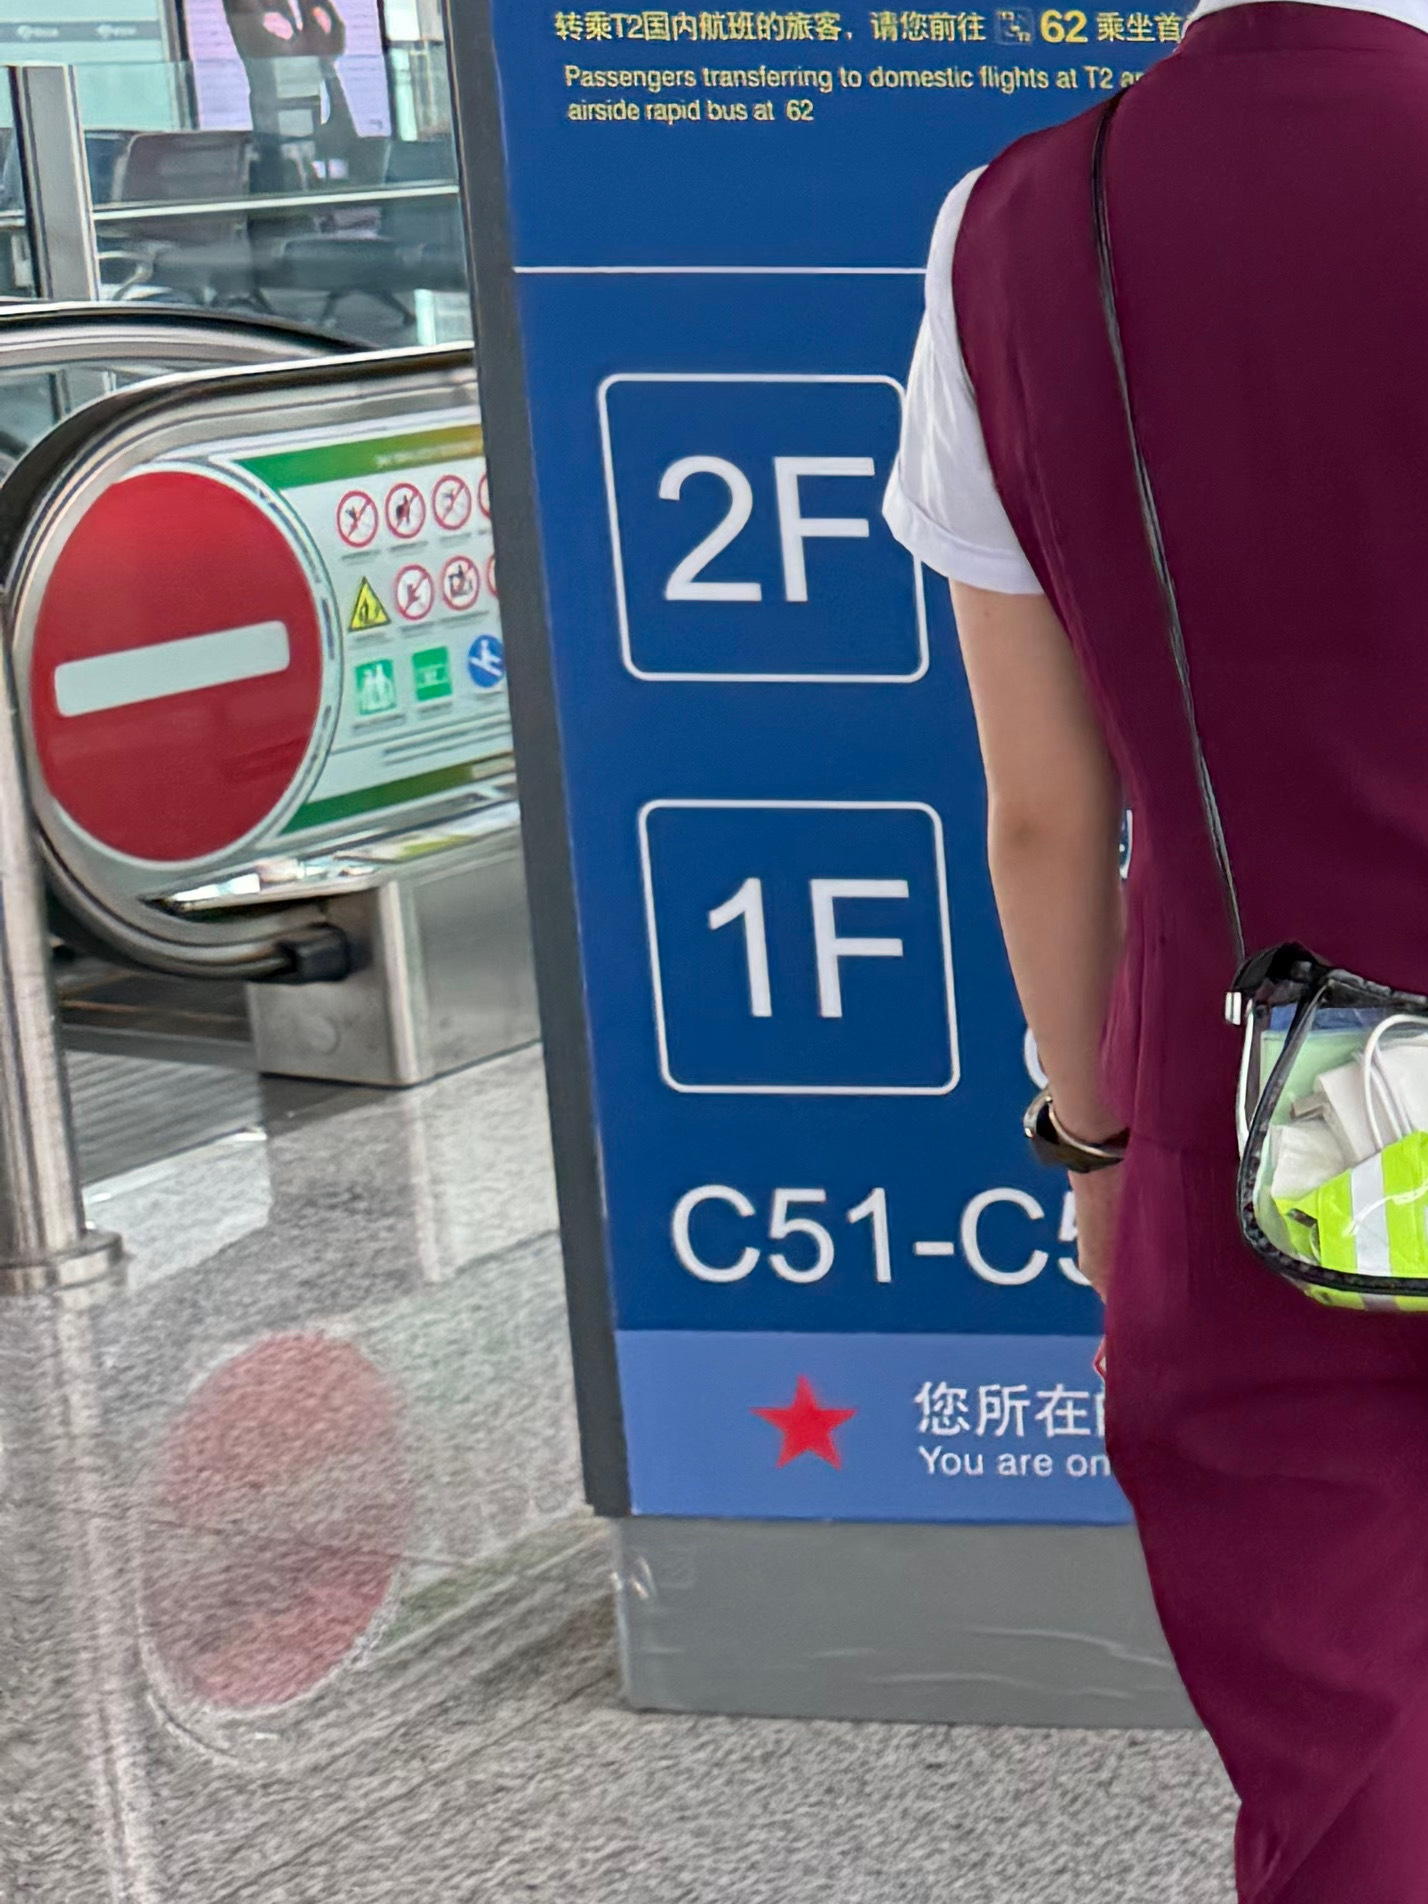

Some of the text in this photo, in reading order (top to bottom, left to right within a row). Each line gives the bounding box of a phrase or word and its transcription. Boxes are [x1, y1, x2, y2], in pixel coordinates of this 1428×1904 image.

[1039, 9, 1089, 43] 62
[564, 64, 697, 93] Passengers
[702, 64, 833, 94] transferring
[839, 65, 862, 88] to
[868, 65, 974, 89] domestic
[979, 64, 1049, 94] flights
[1055, 66, 1078, 89] at
[1082, 65, 1114, 89] T2
[567, 98, 815, 126] airside rapid bus at 62
[657, 454, 876, 603] 2F
[706, 876, 910, 1020] 1F
[914, 1379, 1105, 1439] 您所在
[918, 1444, 1112, 1477] You are on
